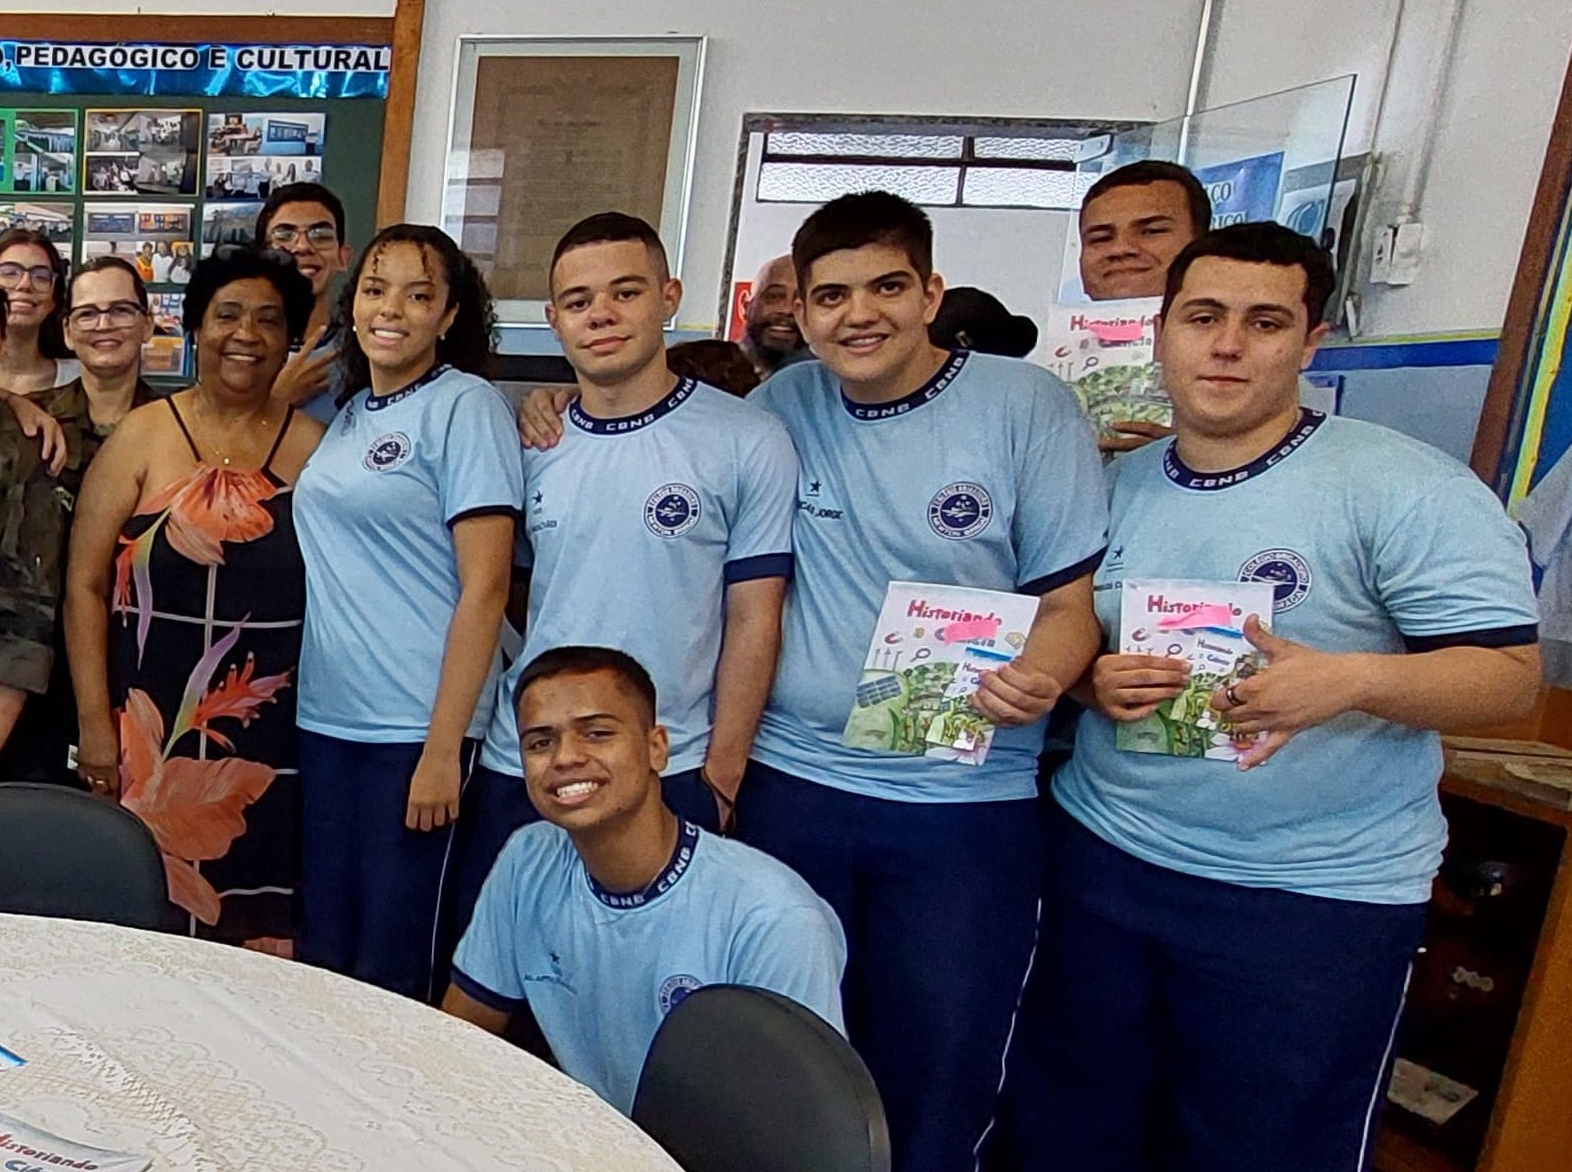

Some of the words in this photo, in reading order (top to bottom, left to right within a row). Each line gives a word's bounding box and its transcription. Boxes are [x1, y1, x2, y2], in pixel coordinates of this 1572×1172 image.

[16, 43, 199, 68] PEDAGÓGICO
[210, 49, 225, 67] E
[237, 49, 388, 69] CULTURAL
[925, 356, 964, 399] CBNB
[606, 413, 655, 431] CBNB
[855, 402, 910, 418] CBNB
[1266, 425, 1315, 466] CBNB
[1188, 470, 1249, 488] CBNB
[657, 846, 690, 892] CBNB
